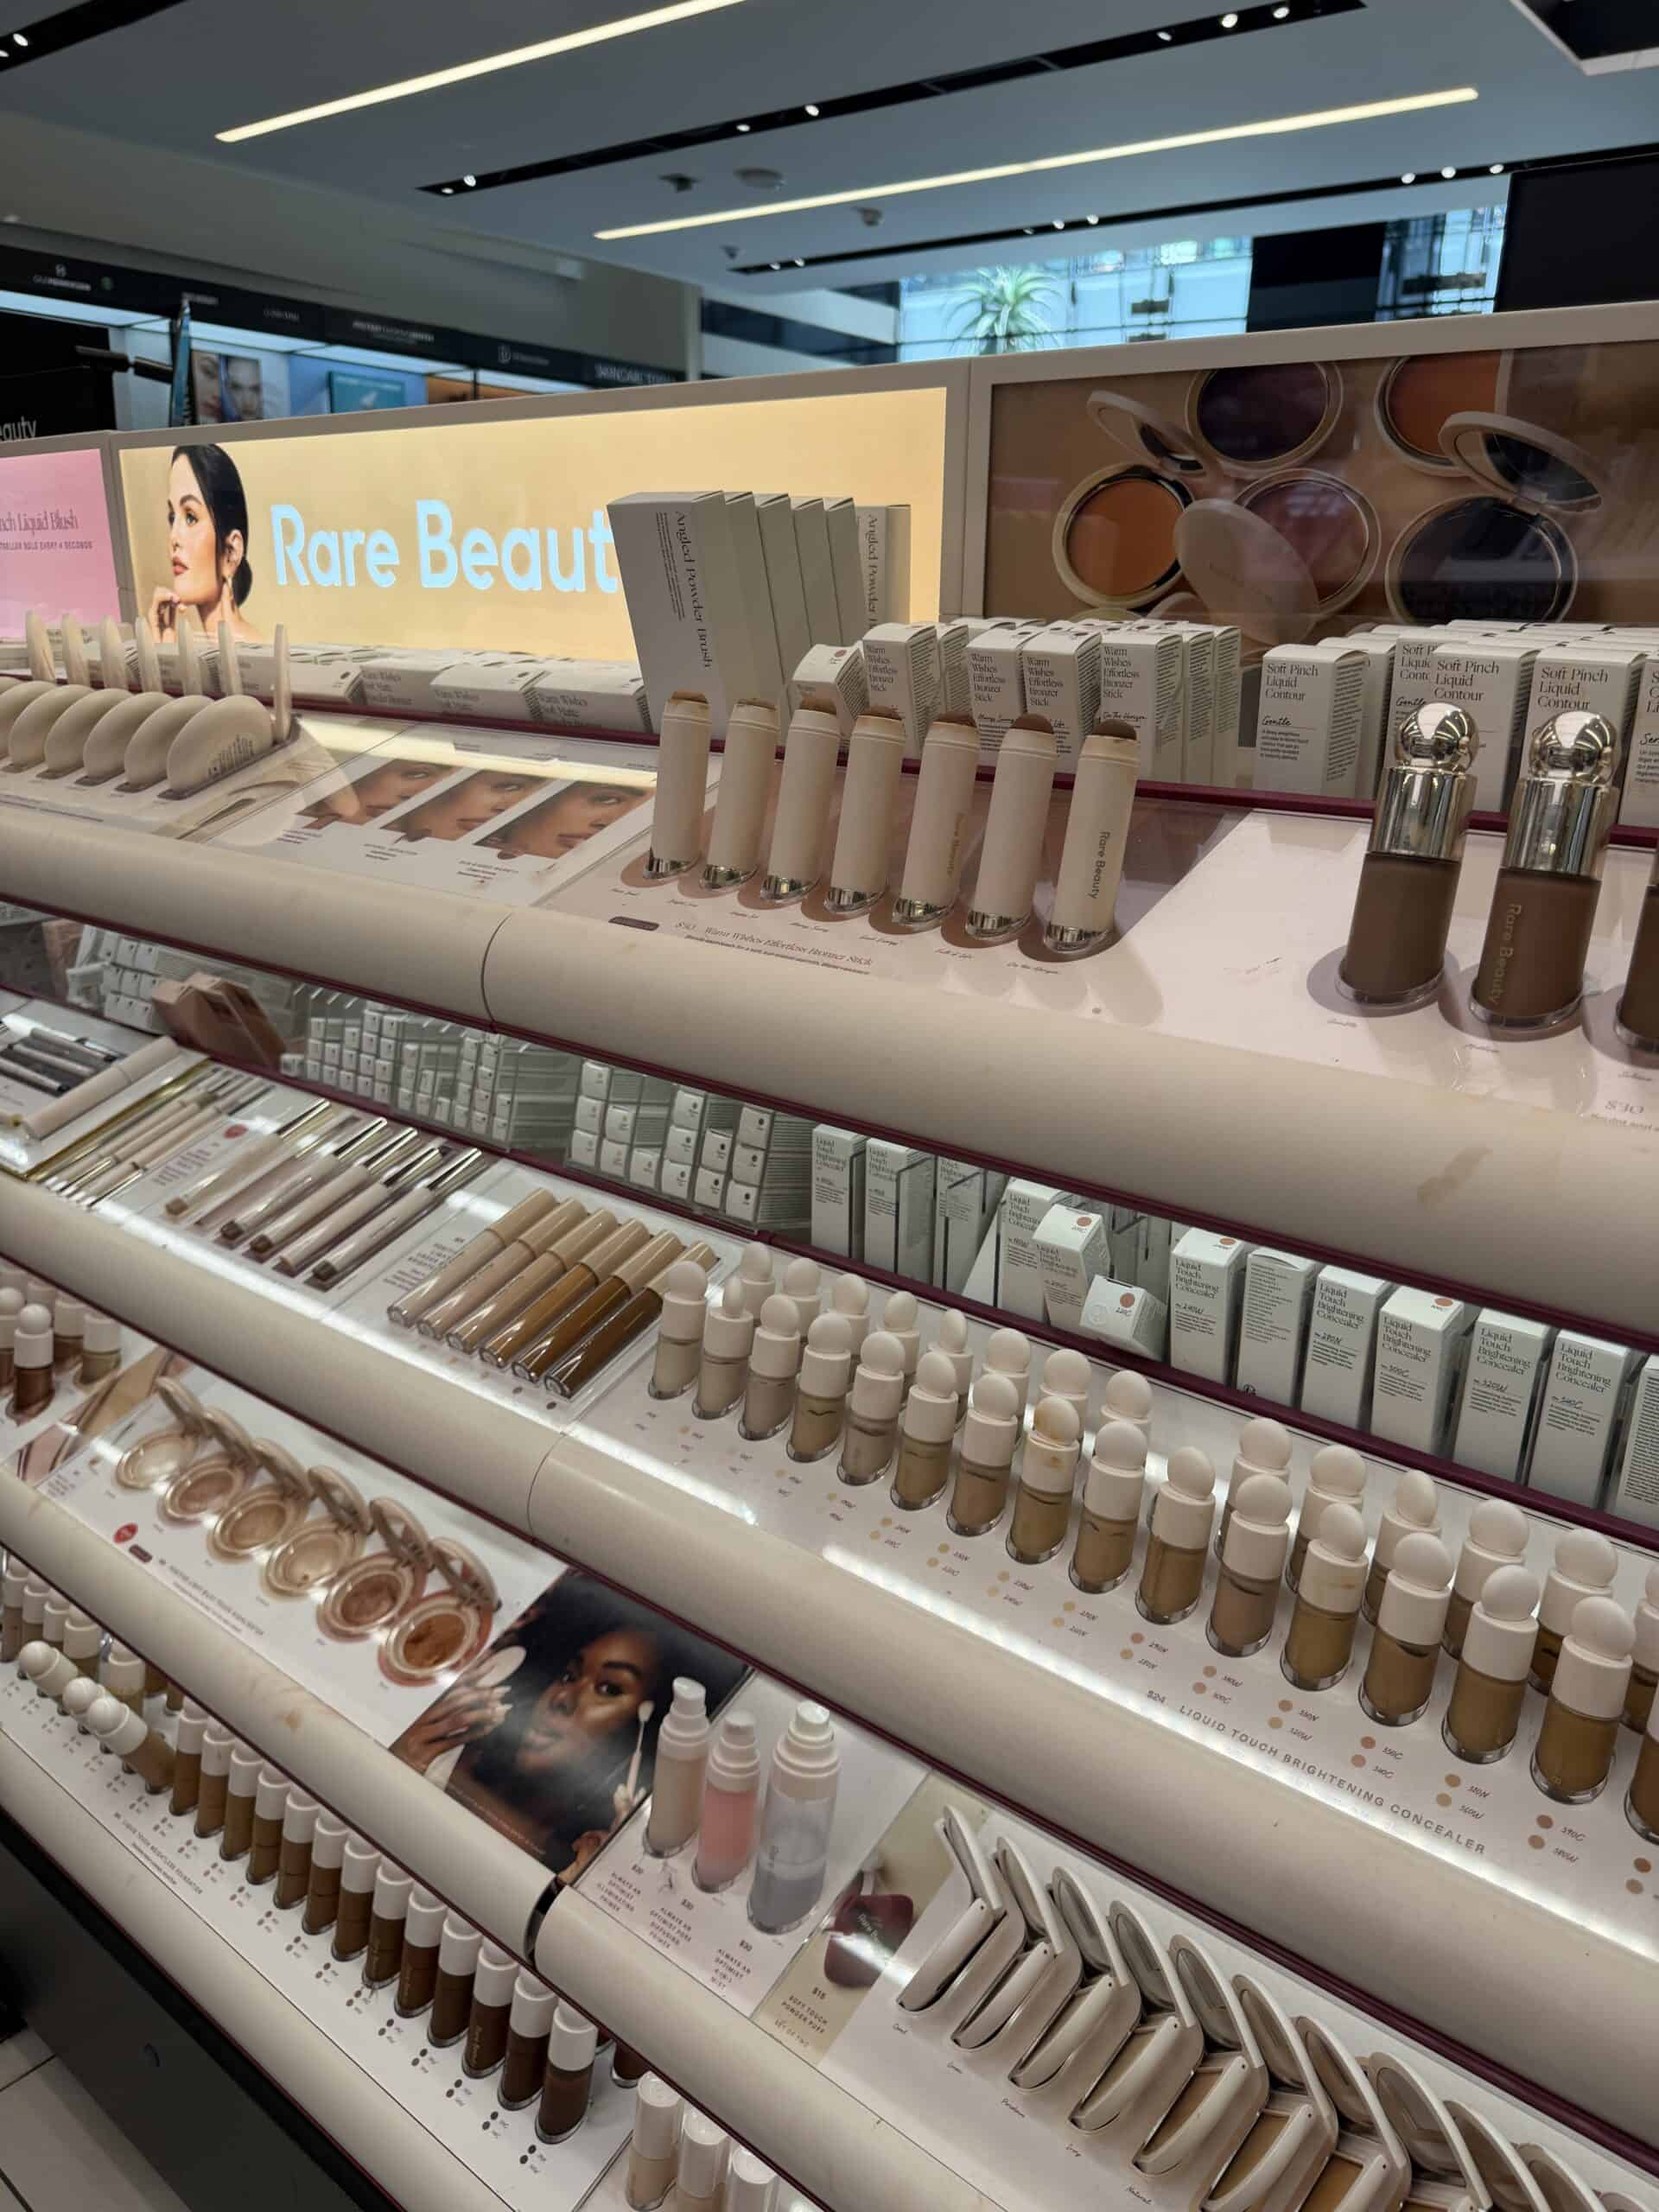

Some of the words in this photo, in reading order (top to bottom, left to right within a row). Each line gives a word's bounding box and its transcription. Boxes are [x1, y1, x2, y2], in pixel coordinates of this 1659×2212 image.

[50, 505, 79, 531] Blush
[675, 510, 696, 563] Angled
[866, 514, 879, 561] Angled
[270, 504, 400, 588] Rare
[415, 499, 619, 594] Beaut
[685, 567, 704, 622] Powder
[867, 564, 879, 613] Powder
[696, 628, 713, 669] Brush
[1103, 645, 1128, 657] Warm
[1402, 644, 1424, 656] Soft
[971, 653, 993, 664] Warm
[1027, 656, 1050, 667] Warm
[1103, 657, 1132, 668] Wishes
[972, 664, 998, 674] Wishes
[1027, 666, 1055, 677] Wishes
[1103, 667, 1141, 678] Effortless
[1266, 663, 1287, 675] Soft
[1289, 663, 1319, 677] Pinch
[1399, 668, 1429, 682] Cont
[1436, 658, 1463, 672] Soft
[1465, 659, 1500, 676] Pinch
[1540, 666, 1568, 681] Soft
[1570, 667, 1610, 684] Pinch
[973, 673, 1007, 684] Effortless
[1028, 677, 1065, 688] Effortless
[1103, 678, 1134, 690] Bronzer
[1265, 675, 1298, 690] Liquid
[1434, 672, 1474, 689] Liquid
[974, 683, 1002, 694] Bronzer
[1029, 687, 1058, 697] Bronzer
[1102, 690, 1124, 699] Stick
[1264, 688, 1306, 702] Contour
[1433, 686, 1485, 702] Contour
[1539, 681, 1581, 697] Liquid
[975, 693, 993, 702] Stick
[1030, 696, 1049, 707] Stick
[1537, 695, 1592, 711] Contour
[1262, 716, 1293, 727] Gentle
[1097, 830, 1111, 858] Rare
[1088, 859, 1106, 899] Beauty
[1504, 903, 1522, 942] Rare
[732, 931, 763, 946] Wishes
[764, 938, 807, 955] Effortless
[808, 946, 846, 962] Bronzer
[847, 954, 874, 967] Stick
[1486, 946, 1514, 1005] Beauty
[1009, 1193, 1031, 1206] Liquid
[1009, 1204, 1030, 1215] Touch
[1008, 1211, 1042, 1225] Brightenin
[1175, 1258, 1202, 1272] Liquid
[1177, 1266, 1202, 1281] Touch
[1175, 1274, 1220, 1294] Brightening
[1175, 1283, 1217, 1300] Concealer
[1319, 1282, 1348, 1299] Liquid
[1319, 1292, 1346, 1308] Touch
[1316, 1309, 1361, 1330] Concealer
[1317, 1300, 1364, 1324] Brightening
[1383, 1316, 1413, 1332] Liquid
[1384, 1325, 1412, 1341] Touch
[1480, 1327, 1513, 1343] Liquid
[1382, 1333, 1433, 1357] Brightening
[1382, 1343, 1427, 1363] Concealer
[1481, 1338, 1511, 1353] Touch
[1560, 1343, 1593, 1361] Liquid
[1476, 1356, 1526, 1376] Concealer
[1478, 1346, 1531, 1370] Brightening
[1560, 1354, 1592, 1370] Touch
[1554, 1371, 1606, 1394] Concealer
[1557, 1361, 1612, 1389] Brightening
[1179, 1704, 1226, 1732] LIQUID
[1230, 1729, 1279, 1758] TOUCH
[1281, 1752, 1385, 1808] BRIGHTENING
[1389, 1803, 1486, 1855] CONCEALER
[649, 1909, 677, 1931] OPTIMIST
[659, 1906, 683, 1926] ALWAYS
[716, 1948, 741, 1968] ALWAYS
[714, 1956, 744, 1979] OPTIMIST
[780, 2000, 808, 2023] POWDER
[807, 2019, 826, 2034] PUFF
[788, 1994, 806, 2011] SOFT
[805, 2006, 829, 2026] TOUCH
